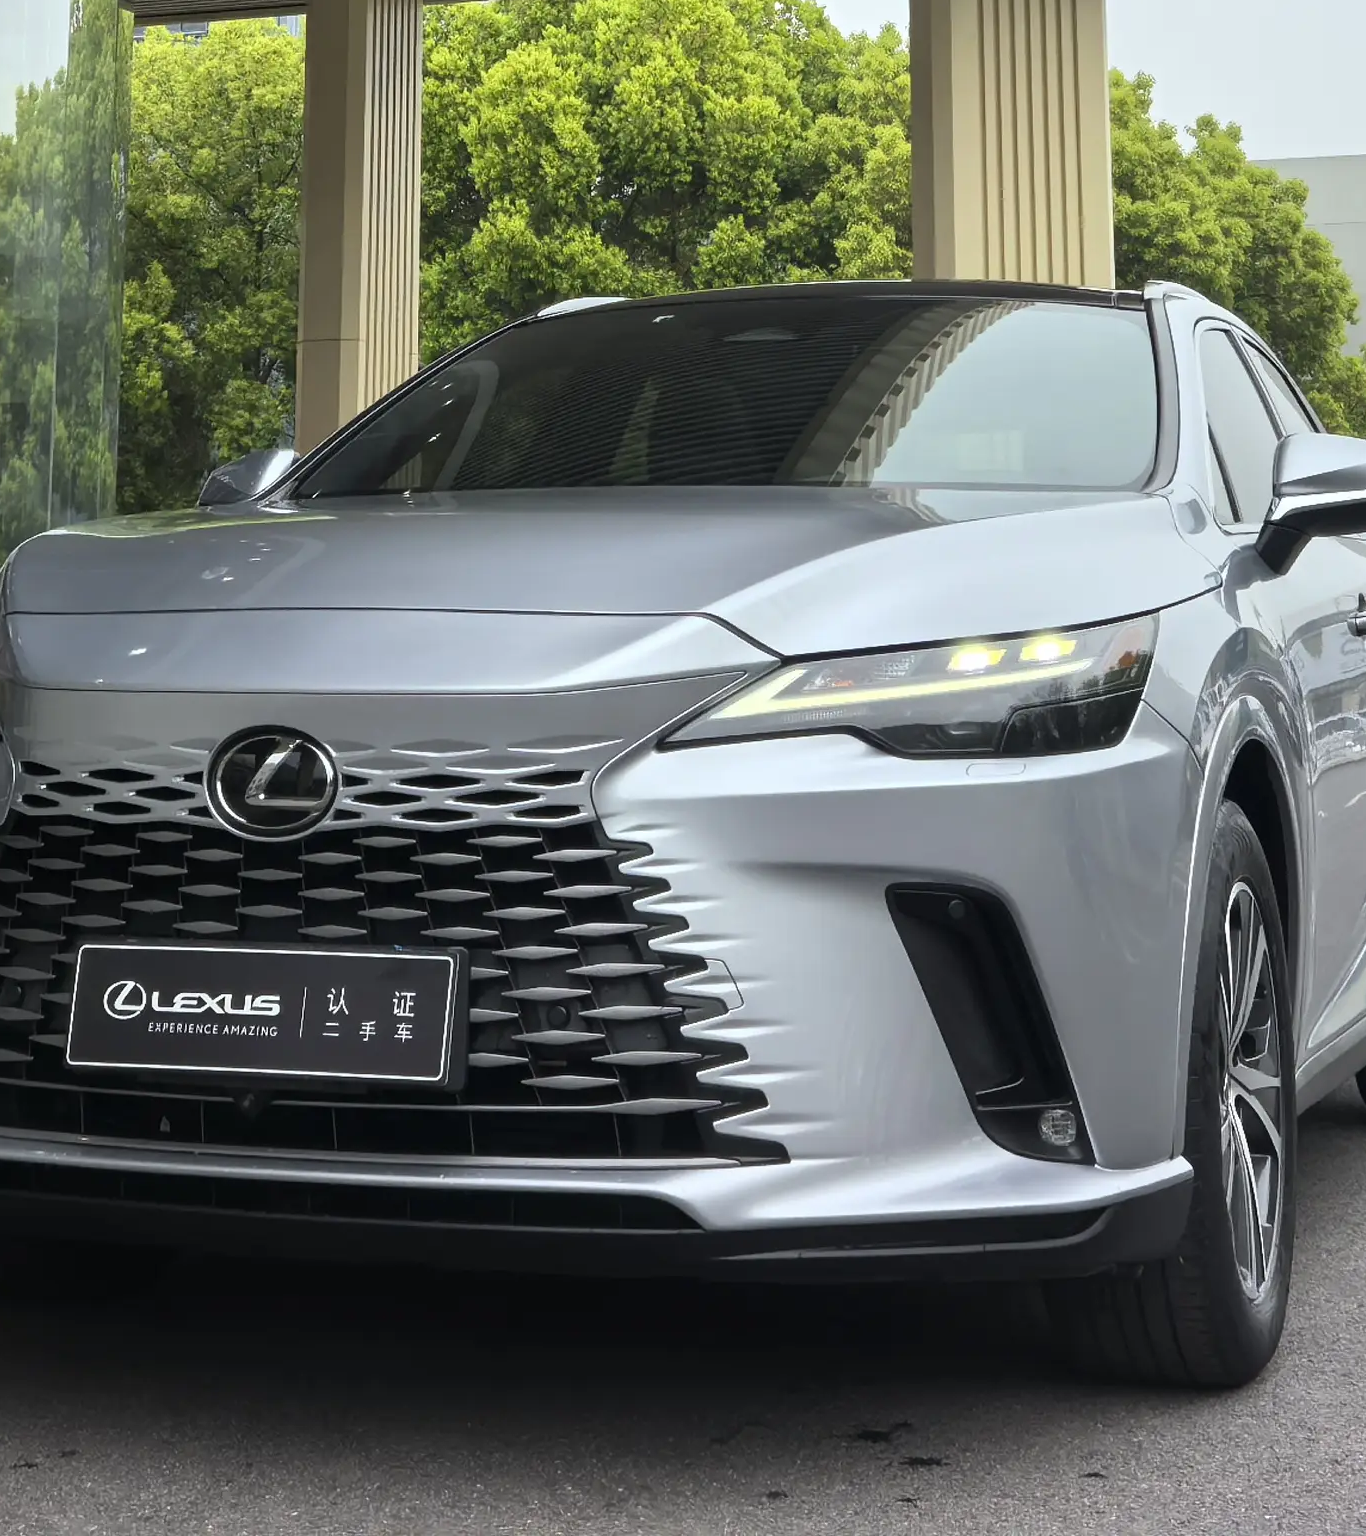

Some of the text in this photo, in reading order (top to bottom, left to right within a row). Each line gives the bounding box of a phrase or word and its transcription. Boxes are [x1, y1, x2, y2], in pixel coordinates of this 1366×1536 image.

[151, 991, 281, 1016] LEXUS
[327, 987, 417, 1017] 认证
[147, 1021, 280, 1038] EXPERIENCE AMAZING
[322, 1019, 414, 1043] 二手车
